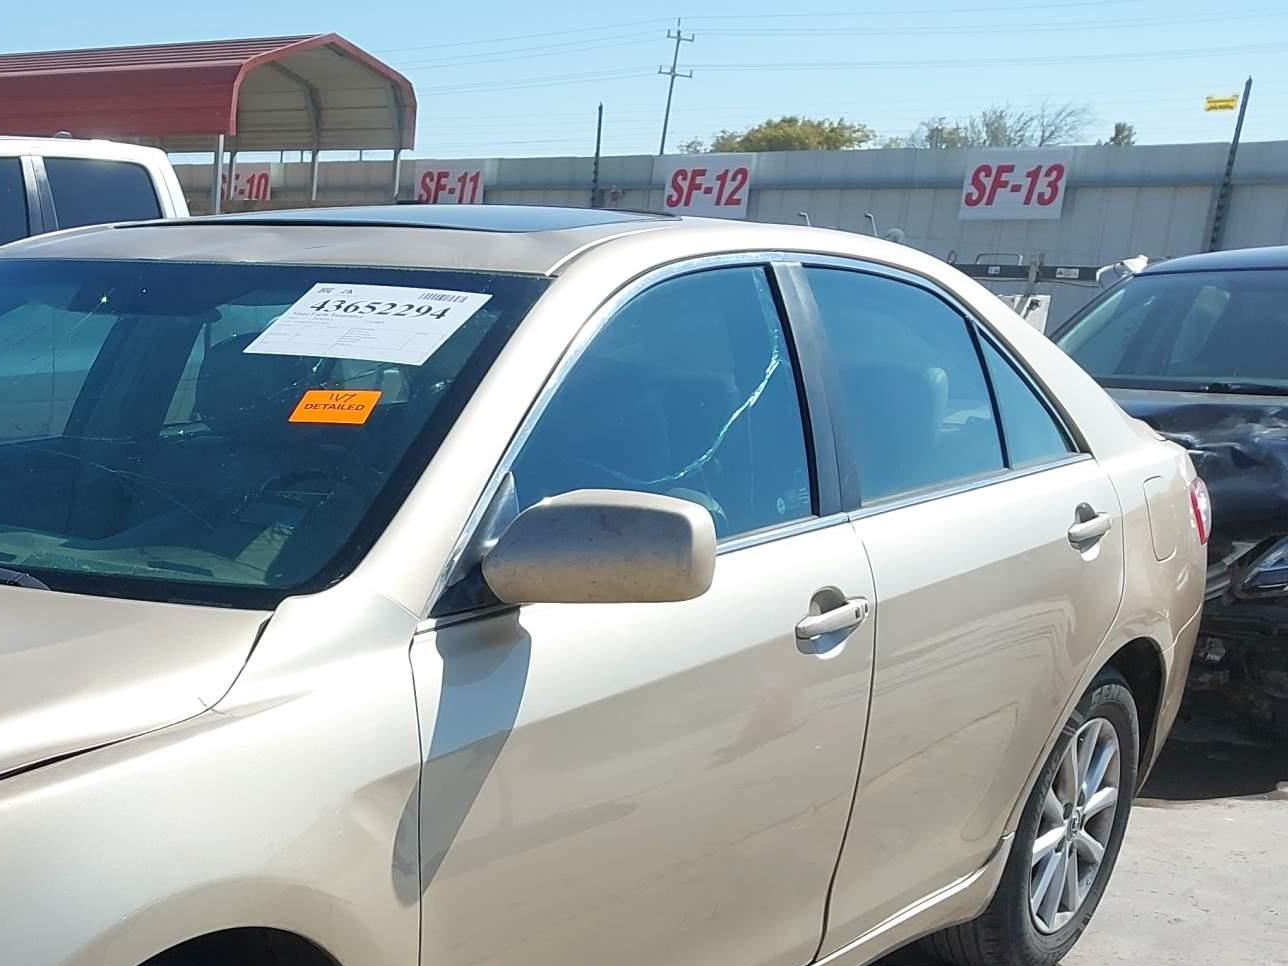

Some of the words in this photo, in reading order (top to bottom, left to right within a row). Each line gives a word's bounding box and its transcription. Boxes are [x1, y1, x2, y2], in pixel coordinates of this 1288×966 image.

[419, 170, 482, 204] SF-11
[666, 167, 749, 208] SF-12
[964, 163, 1065, 206] SF-13
[310, 299, 451, 320] 43652294
[304, 403, 365, 411] DETAILED
